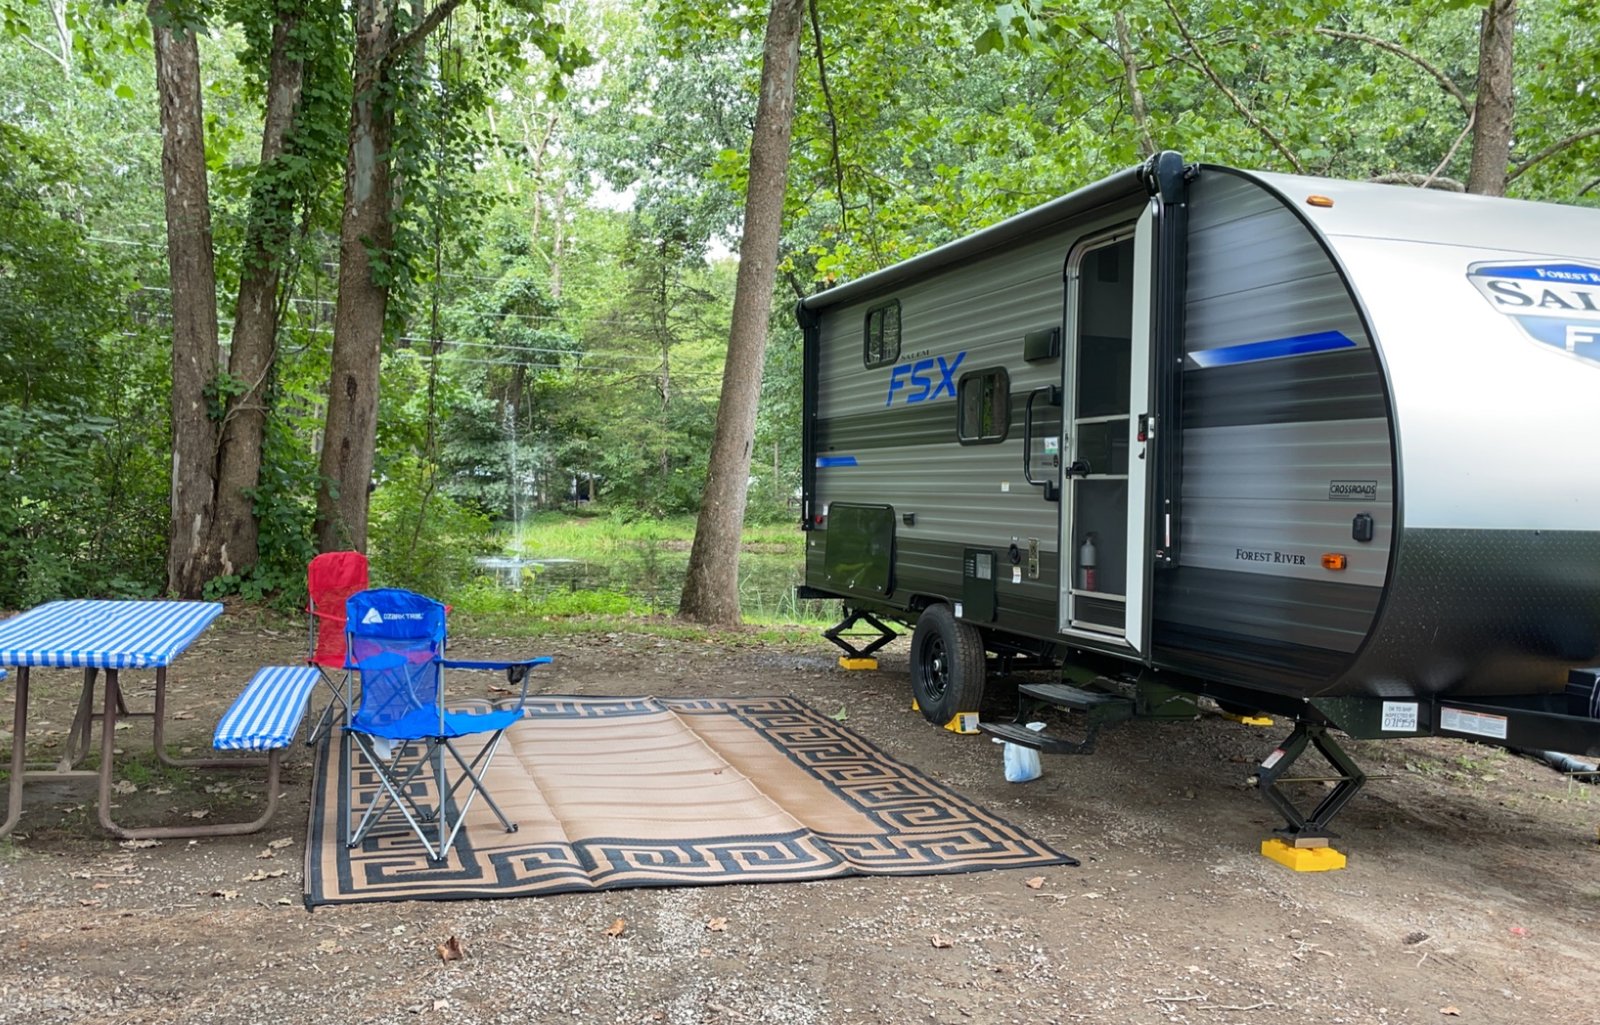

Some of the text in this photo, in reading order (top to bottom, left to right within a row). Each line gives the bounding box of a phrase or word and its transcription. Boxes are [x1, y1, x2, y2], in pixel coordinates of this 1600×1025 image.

[1536, 268, 1588, 281] FOREST
[1566, 324, 1600, 352] F
[886, 351, 967, 407] FSX
[1330, 484, 1376, 494] CROSSROADS
[1235, 548, 1306, 565] FOREST RIVER
